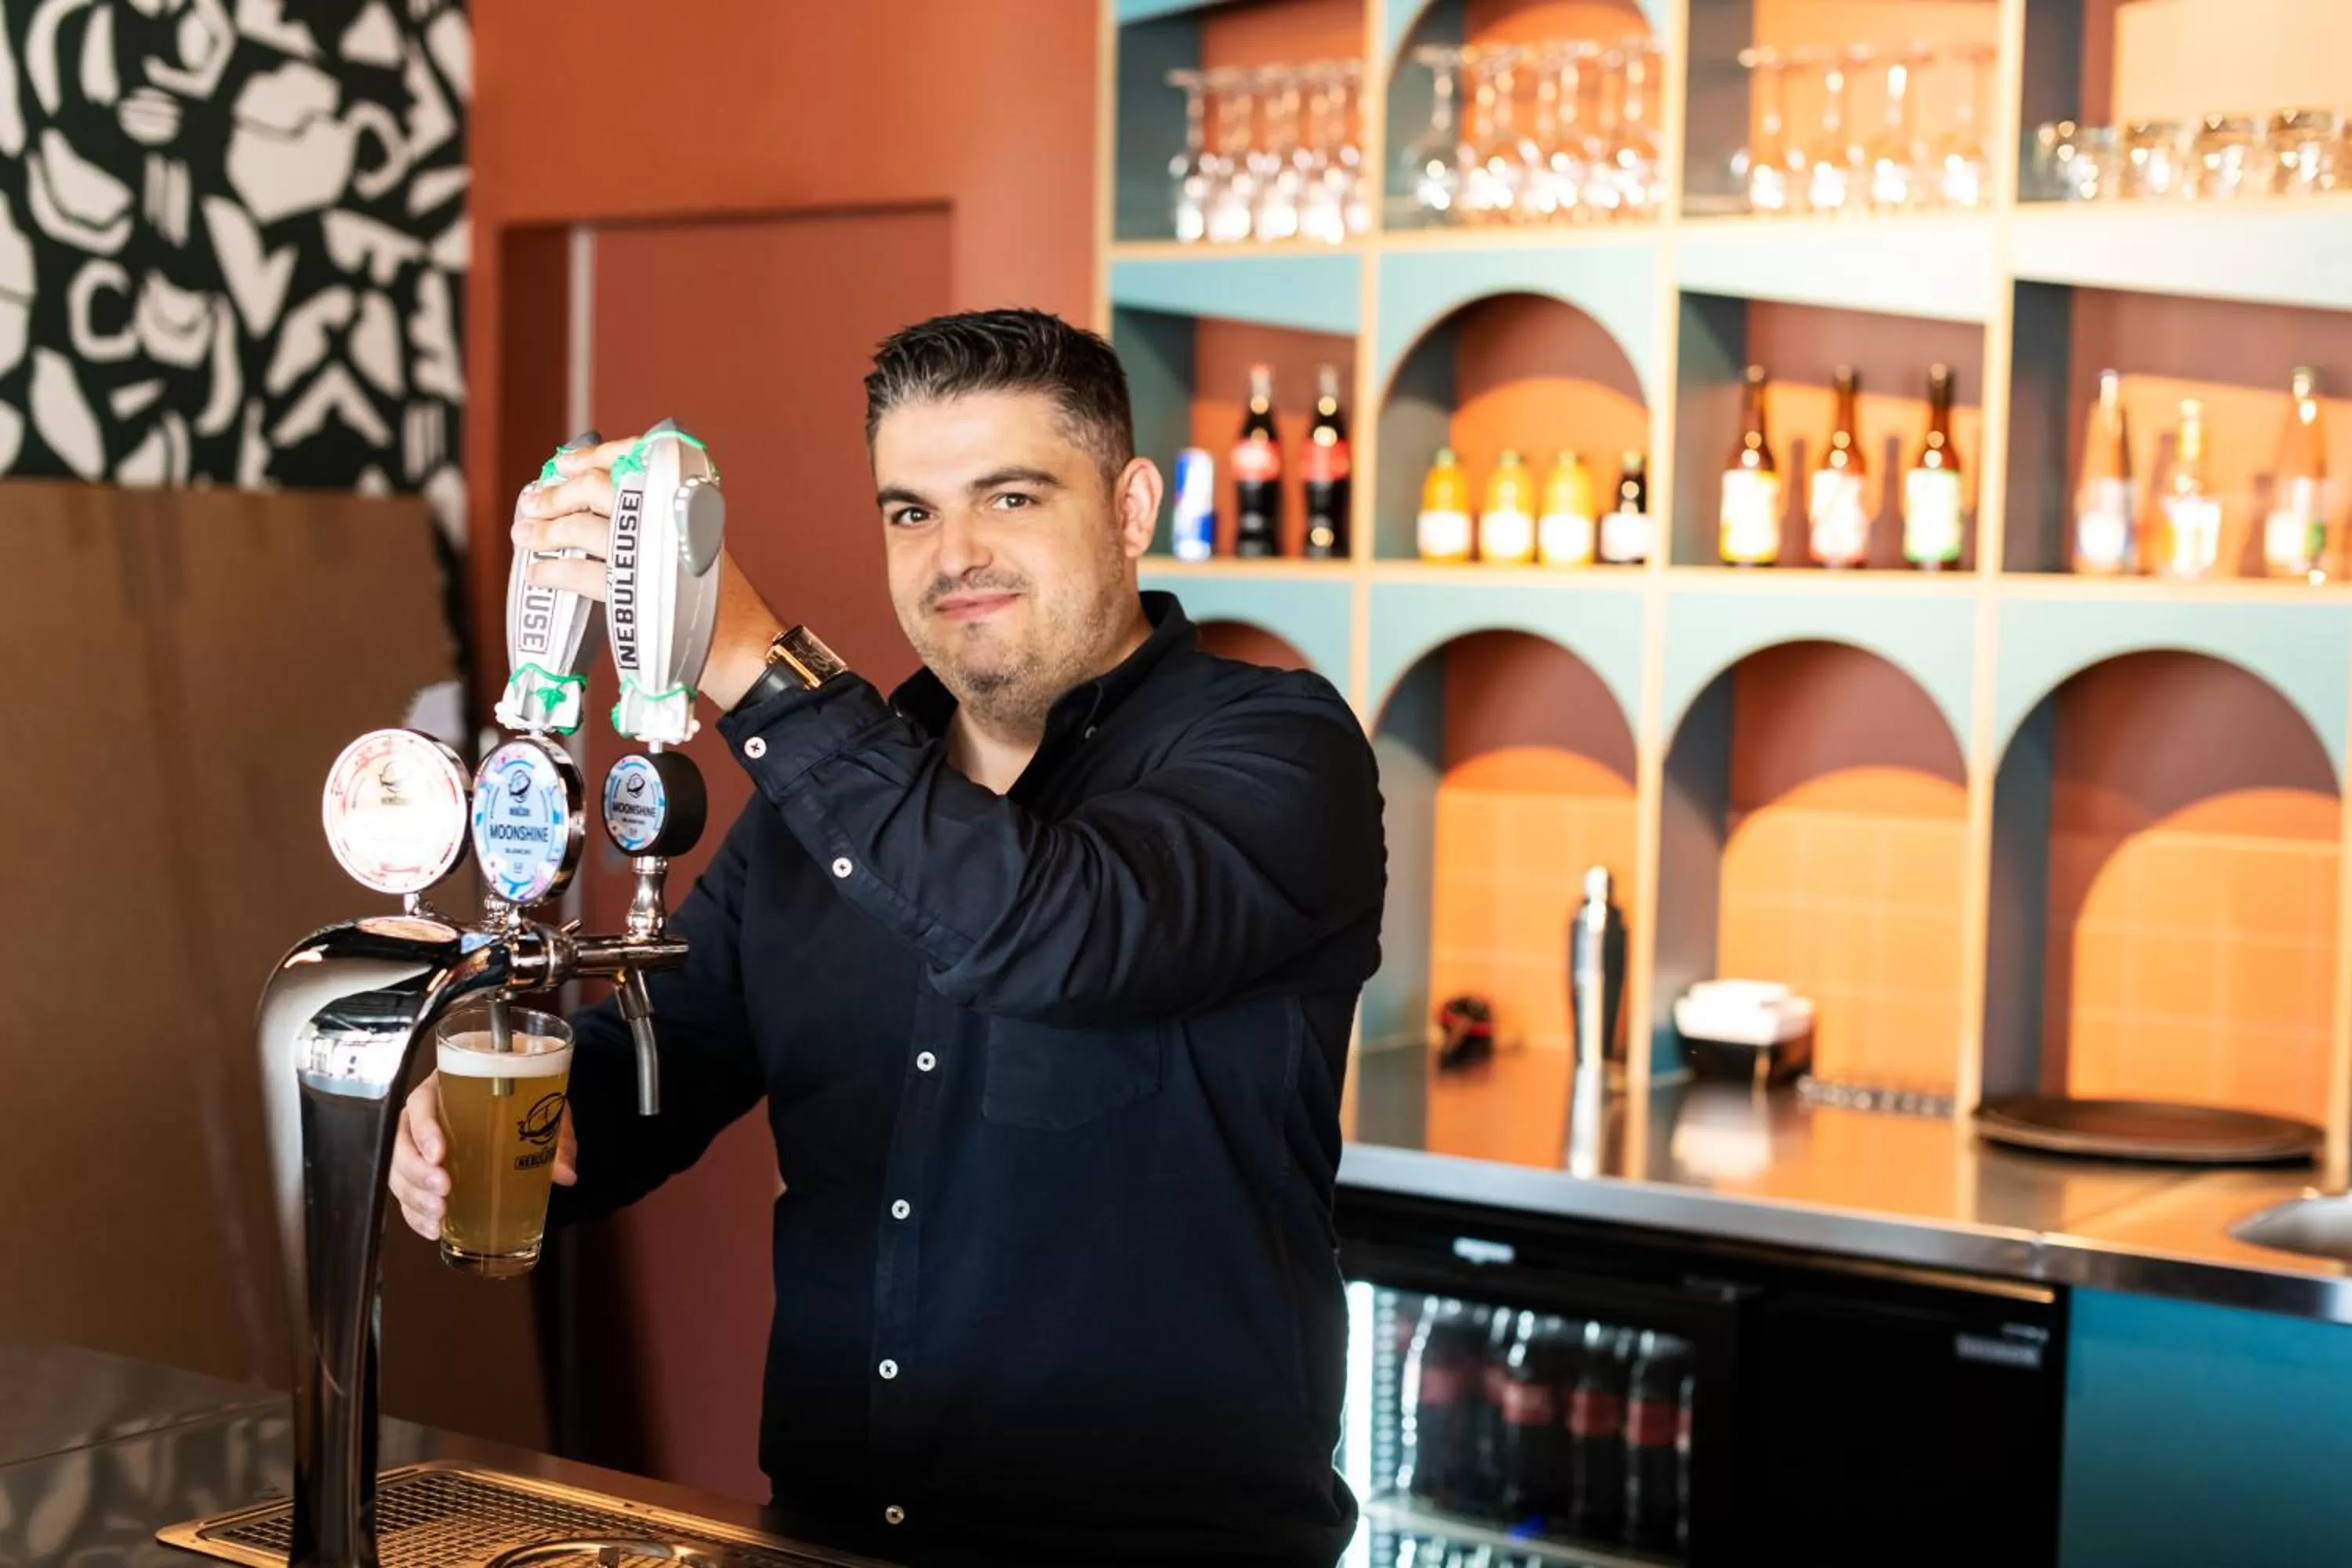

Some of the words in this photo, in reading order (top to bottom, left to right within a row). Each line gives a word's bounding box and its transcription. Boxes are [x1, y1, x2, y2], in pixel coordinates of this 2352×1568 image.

[614, 496, 640, 663] NEBULEUSE
[612, 801, 656, 818] MOONSHINE
[489, 823, 549, 843] MOONSHINE
